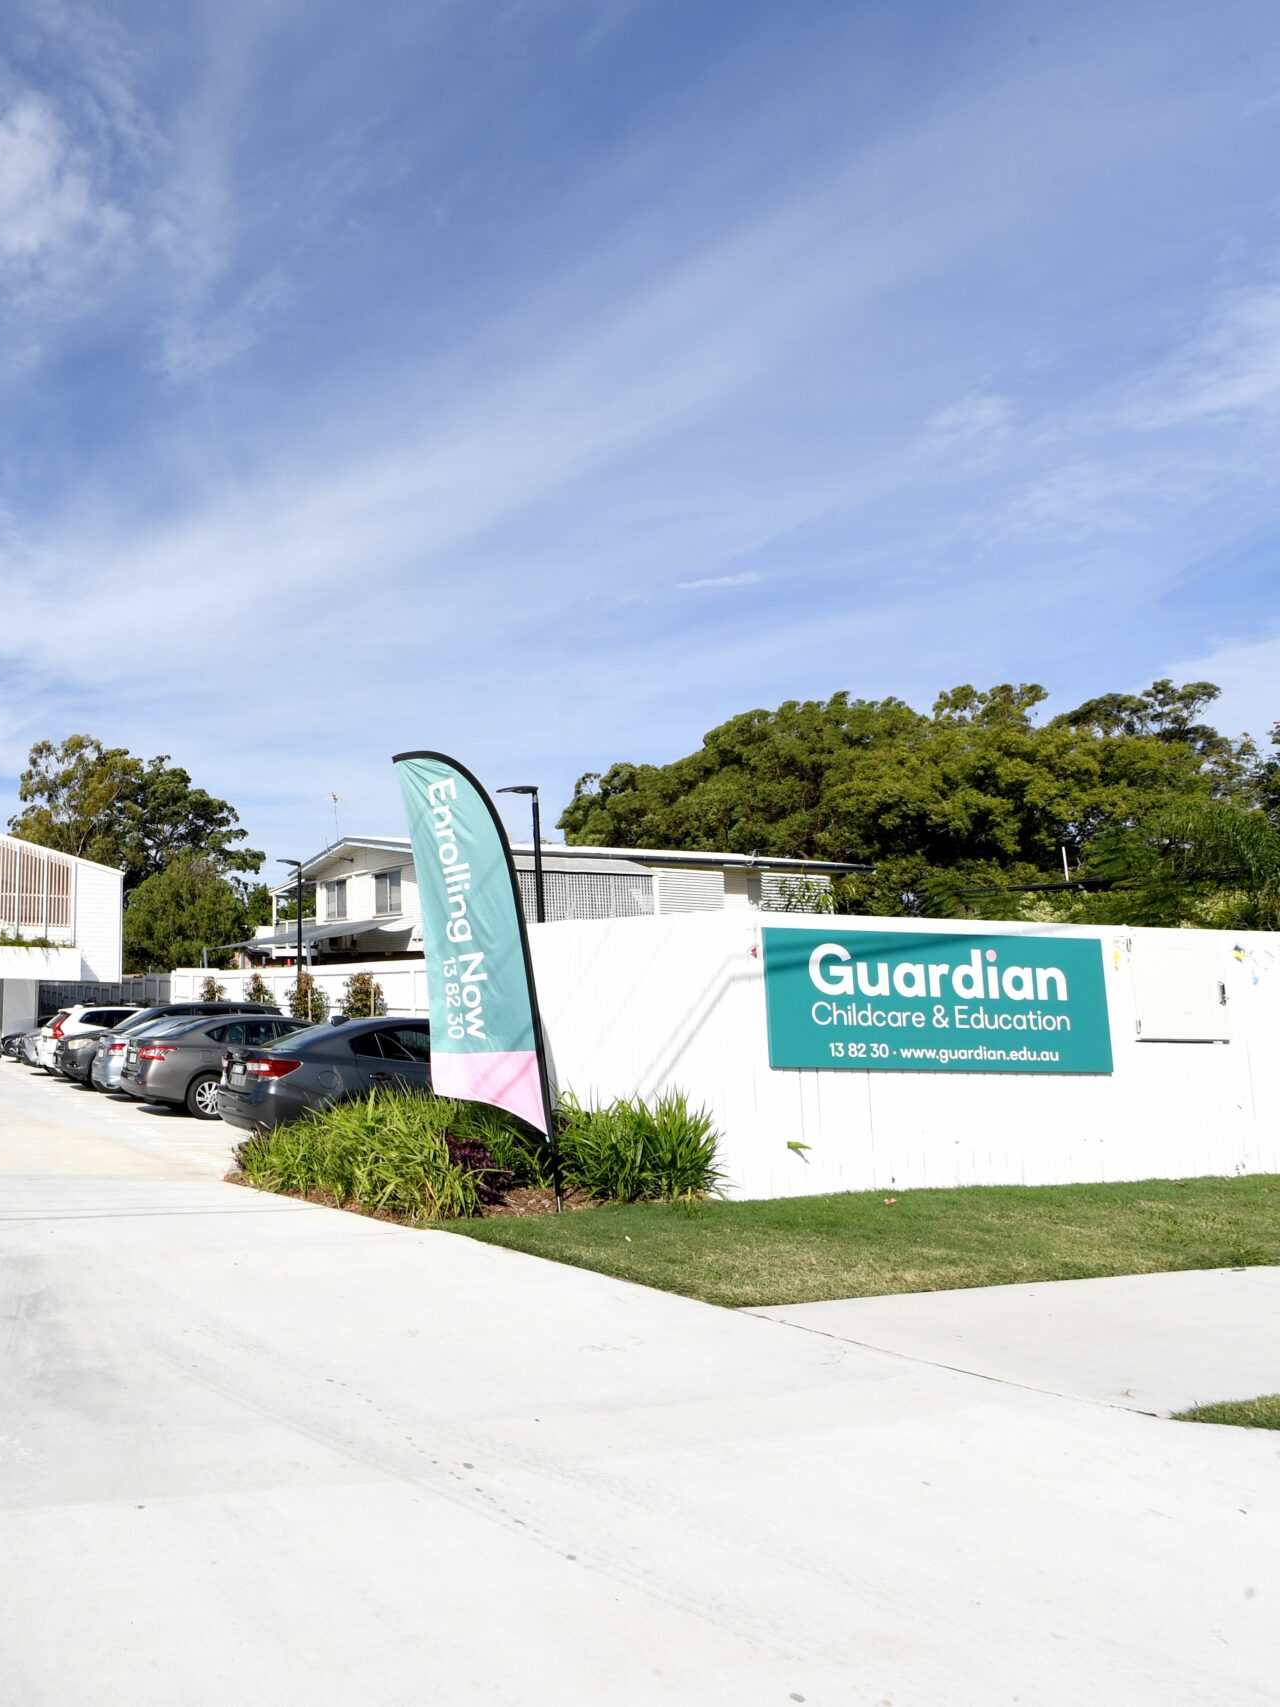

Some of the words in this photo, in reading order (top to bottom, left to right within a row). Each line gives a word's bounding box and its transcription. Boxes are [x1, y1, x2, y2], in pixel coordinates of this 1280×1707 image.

[427, 777, 473, 943] Enrolling
[459, 951, 488, 1040] Now
[442, 956, 458, 978] 13
[808, 942, 1068, 1001] Guardian
[444, 982, 462, 1009] 82
[447, 1012, 465, 1040] 30
[811, 1001, 926, 1028] Childcare
[932, 1004, 950, 1029] &
[954, 1005, 1071, 1031] Education
[828, 1042, 845, 1058] 13
[848, 1042, 867, 1058] 82
[869, 1043, 890, 1059] 30
[899, 1045, 1060, 1064] www.guardian.edu.au
